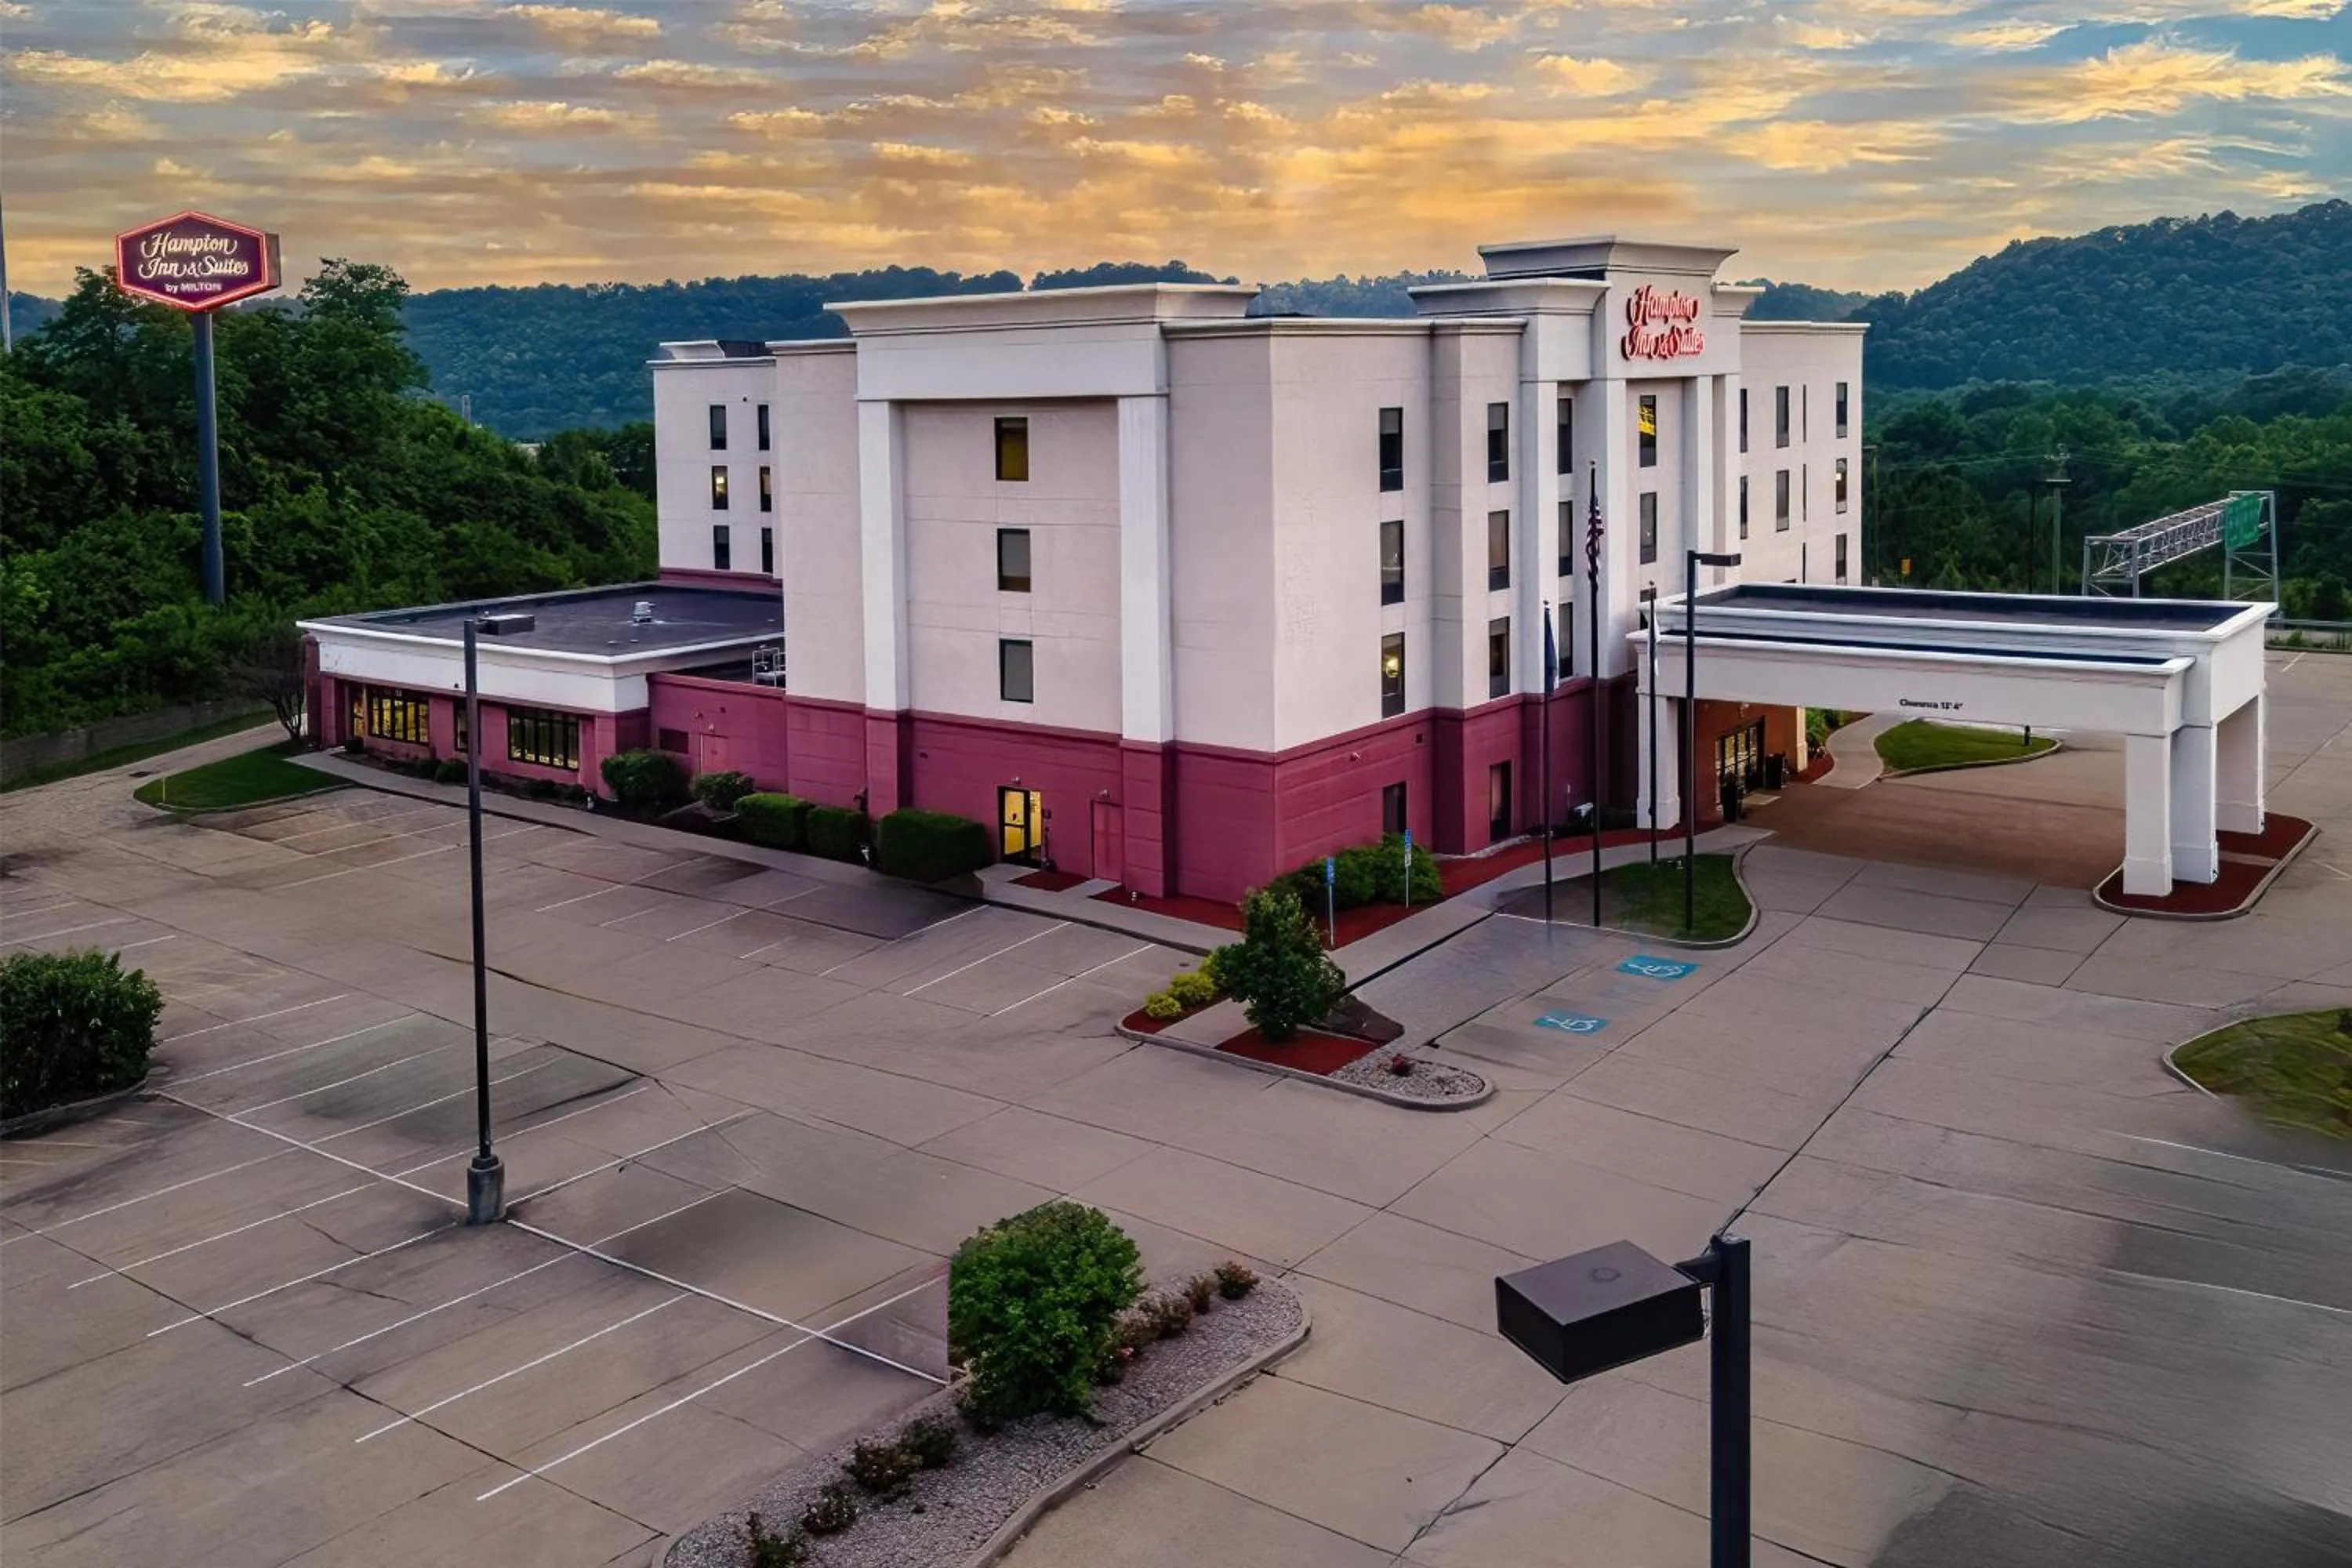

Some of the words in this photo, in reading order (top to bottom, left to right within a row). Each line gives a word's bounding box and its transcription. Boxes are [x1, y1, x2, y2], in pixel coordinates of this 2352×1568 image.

[142, 233, 236, 256] Hampton
[139, 257, 186, 278] Inn
[187, 263, 199, 278] &
[199, 256, 248, 276] Suites
[165, 283, 179, 293] by
